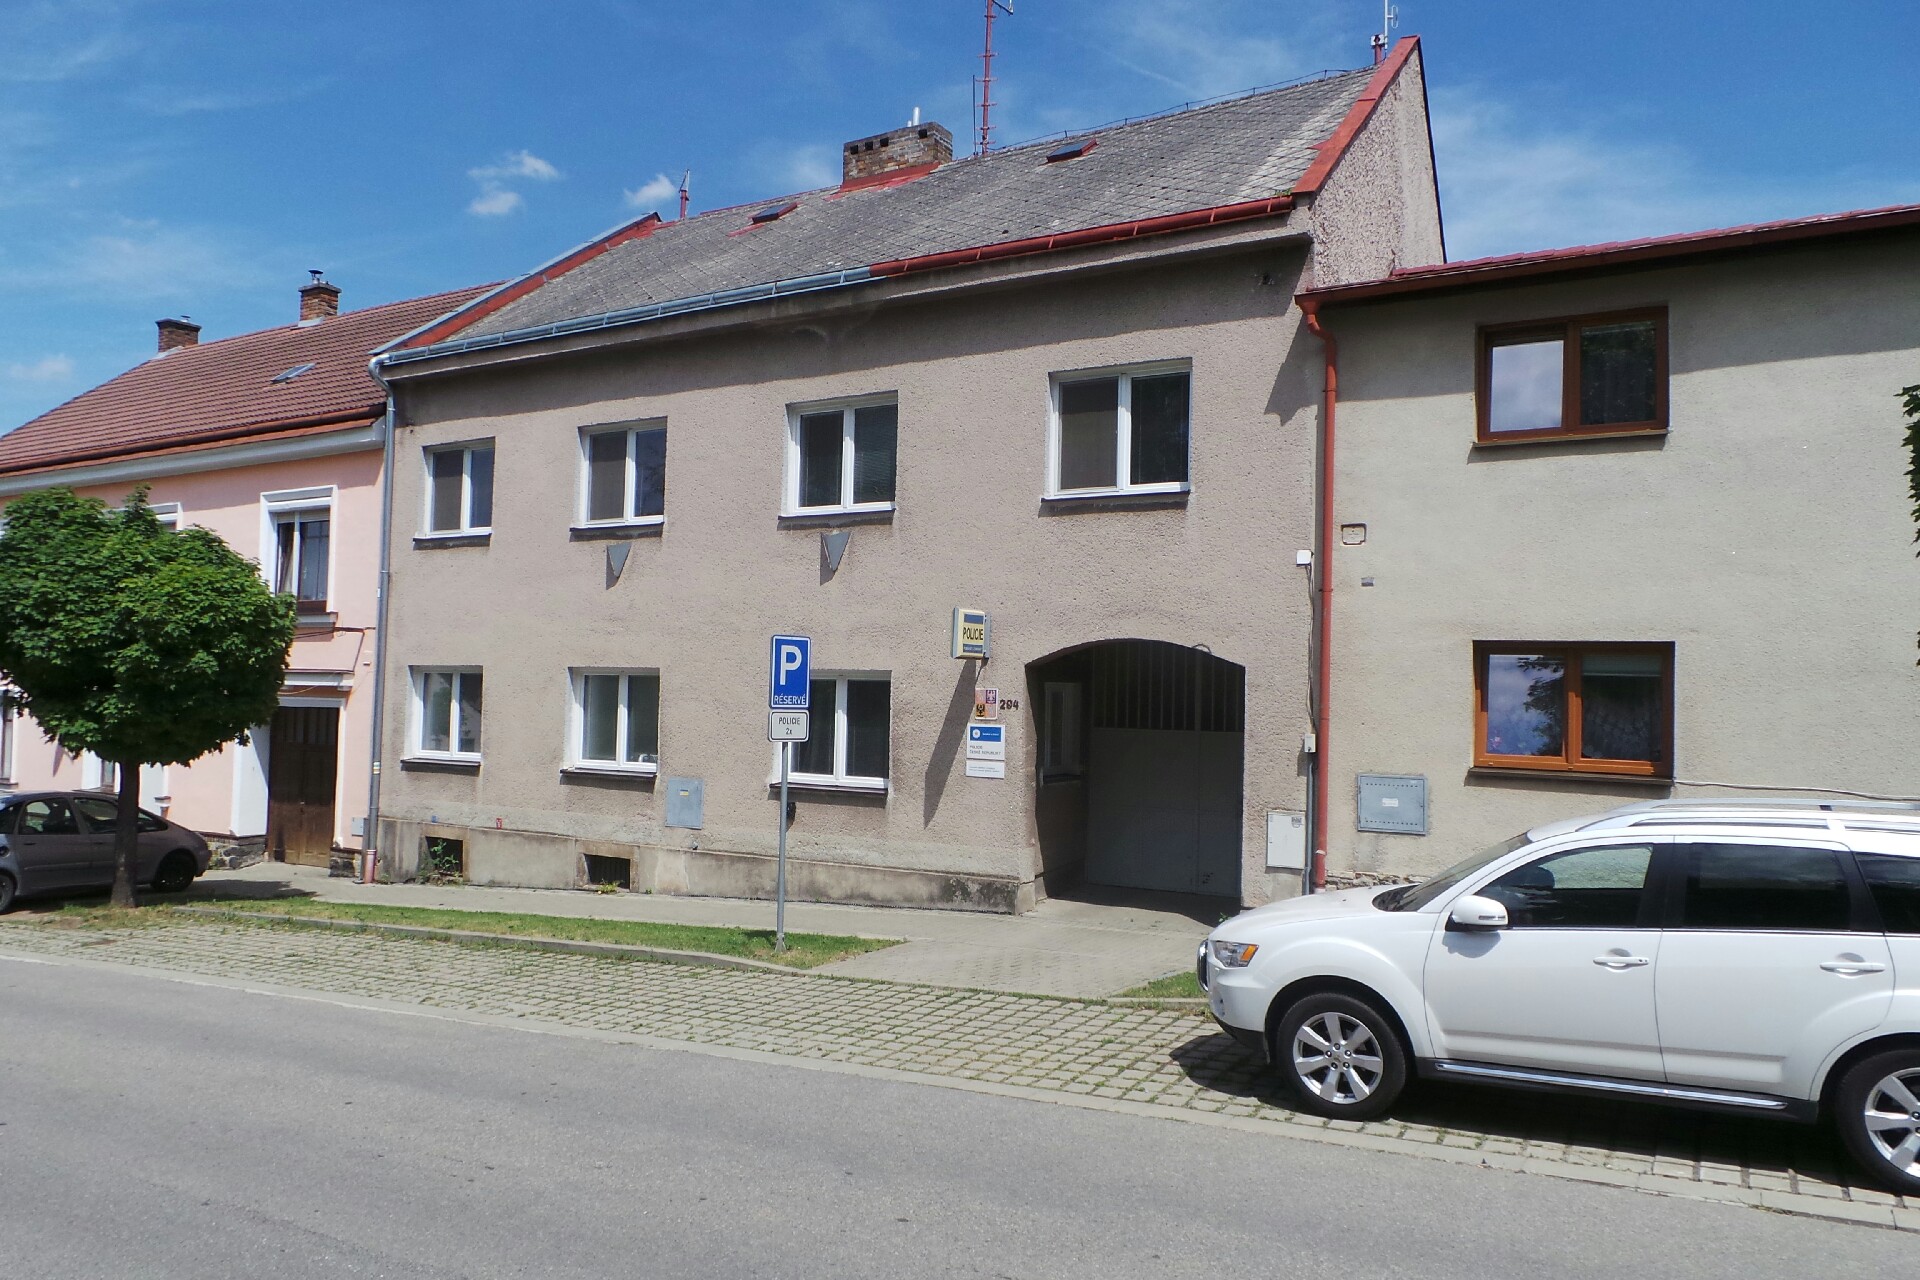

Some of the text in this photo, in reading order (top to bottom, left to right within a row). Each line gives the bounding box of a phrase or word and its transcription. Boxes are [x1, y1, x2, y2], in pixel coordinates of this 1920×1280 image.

[963, 627, 983, 640] POLICIE
[780, 645, 802, 685] P
[774, 693, 806, 704] RÉSERVÉ
[779, 717, 800, 725] POLICIE
